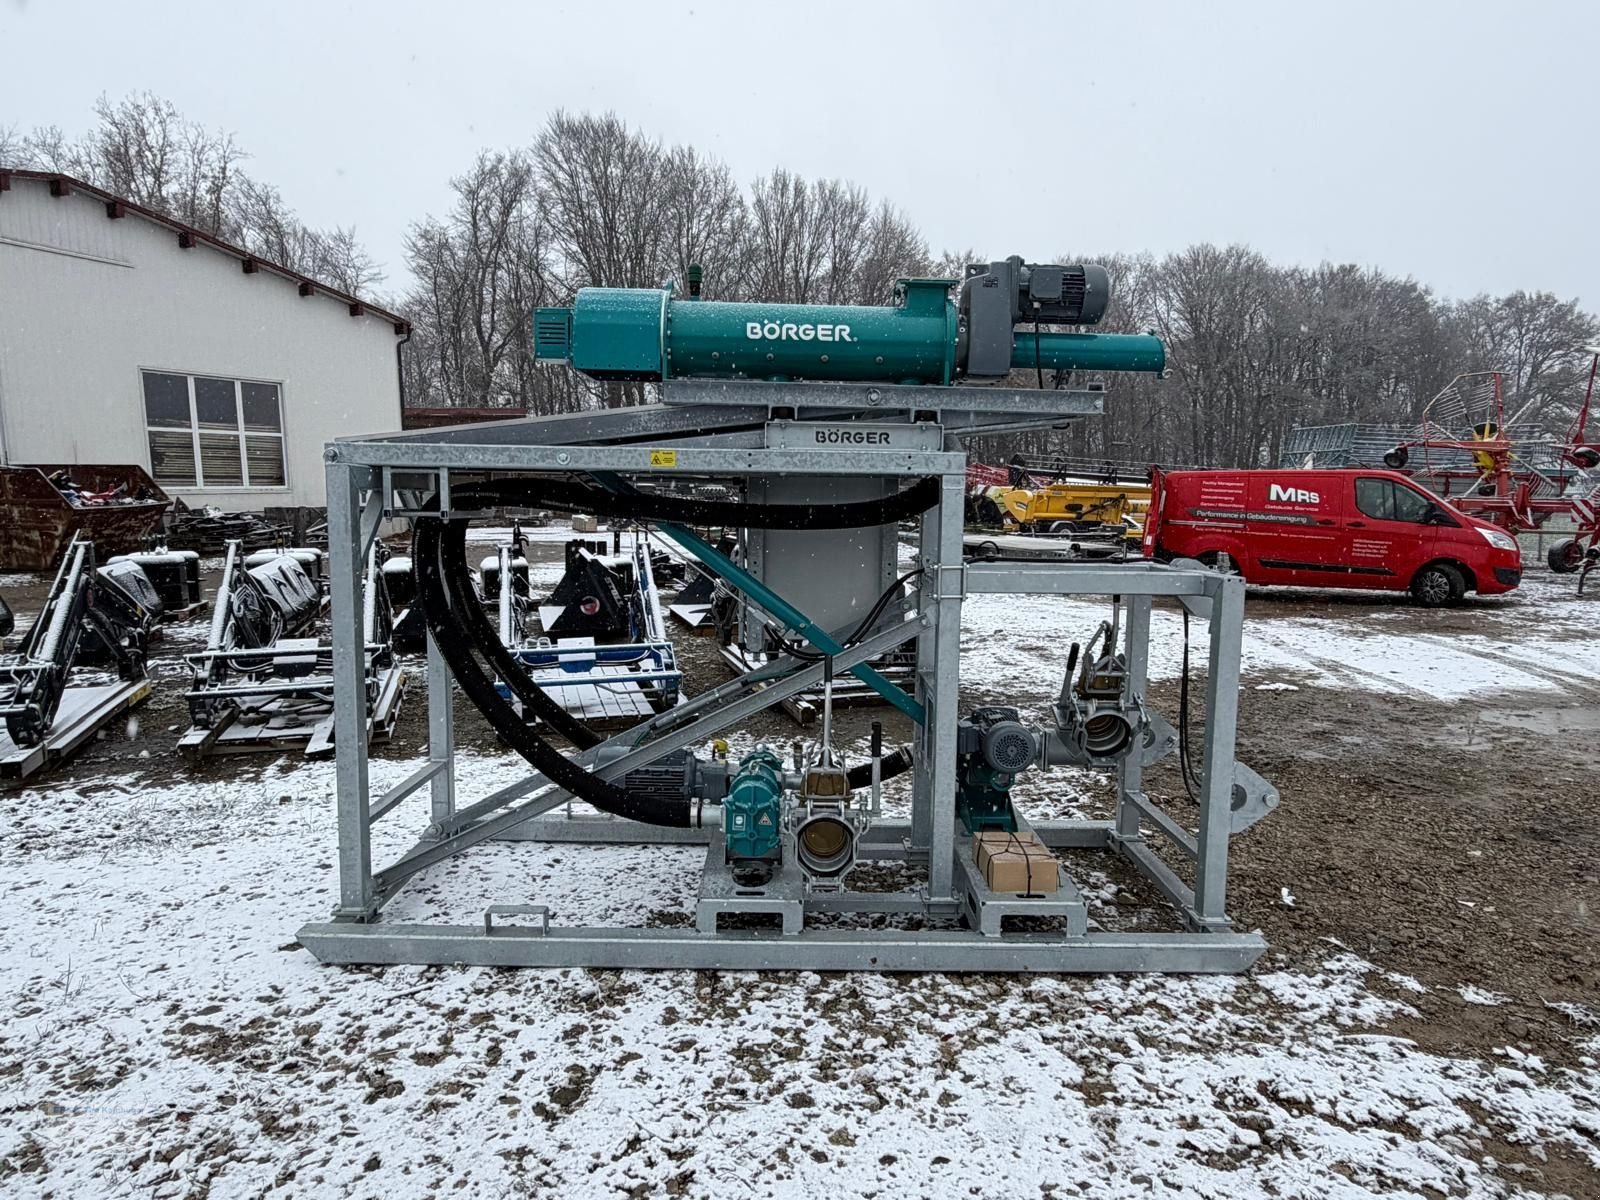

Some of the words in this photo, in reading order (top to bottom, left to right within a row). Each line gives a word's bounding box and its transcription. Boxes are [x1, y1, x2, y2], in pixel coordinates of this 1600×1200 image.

[815, 429, 891, 444] BÖRGER
[1270, 483, 1320, 504] MRS
[1196, 510, 1239, 519] Performance
[1246, 512, 1308, 524] Gebäudereinigung
